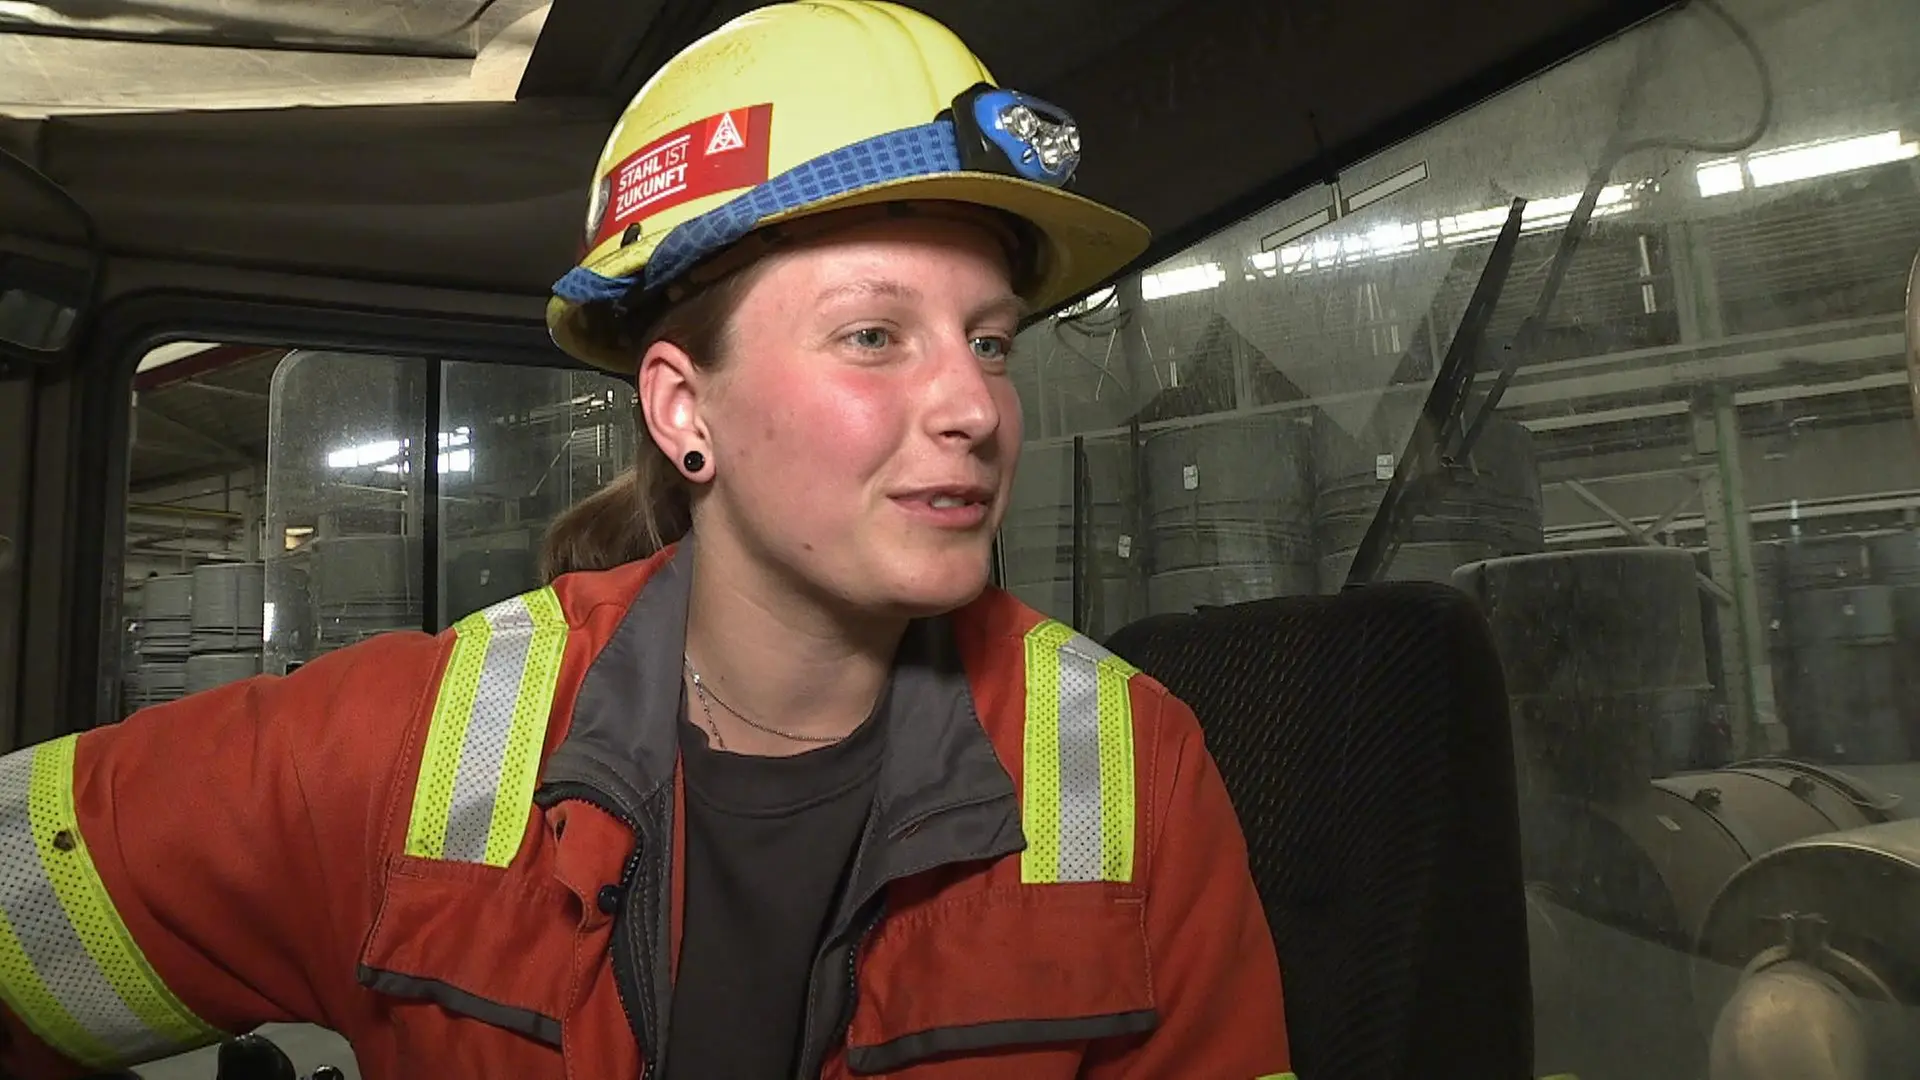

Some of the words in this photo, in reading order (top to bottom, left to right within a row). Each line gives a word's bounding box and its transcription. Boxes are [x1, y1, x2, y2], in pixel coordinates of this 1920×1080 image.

[616, 163, 688, 213] ZUKUNFT
[618, 156, 662, 192] STAHL
[665, 142, 690, 168] IST
